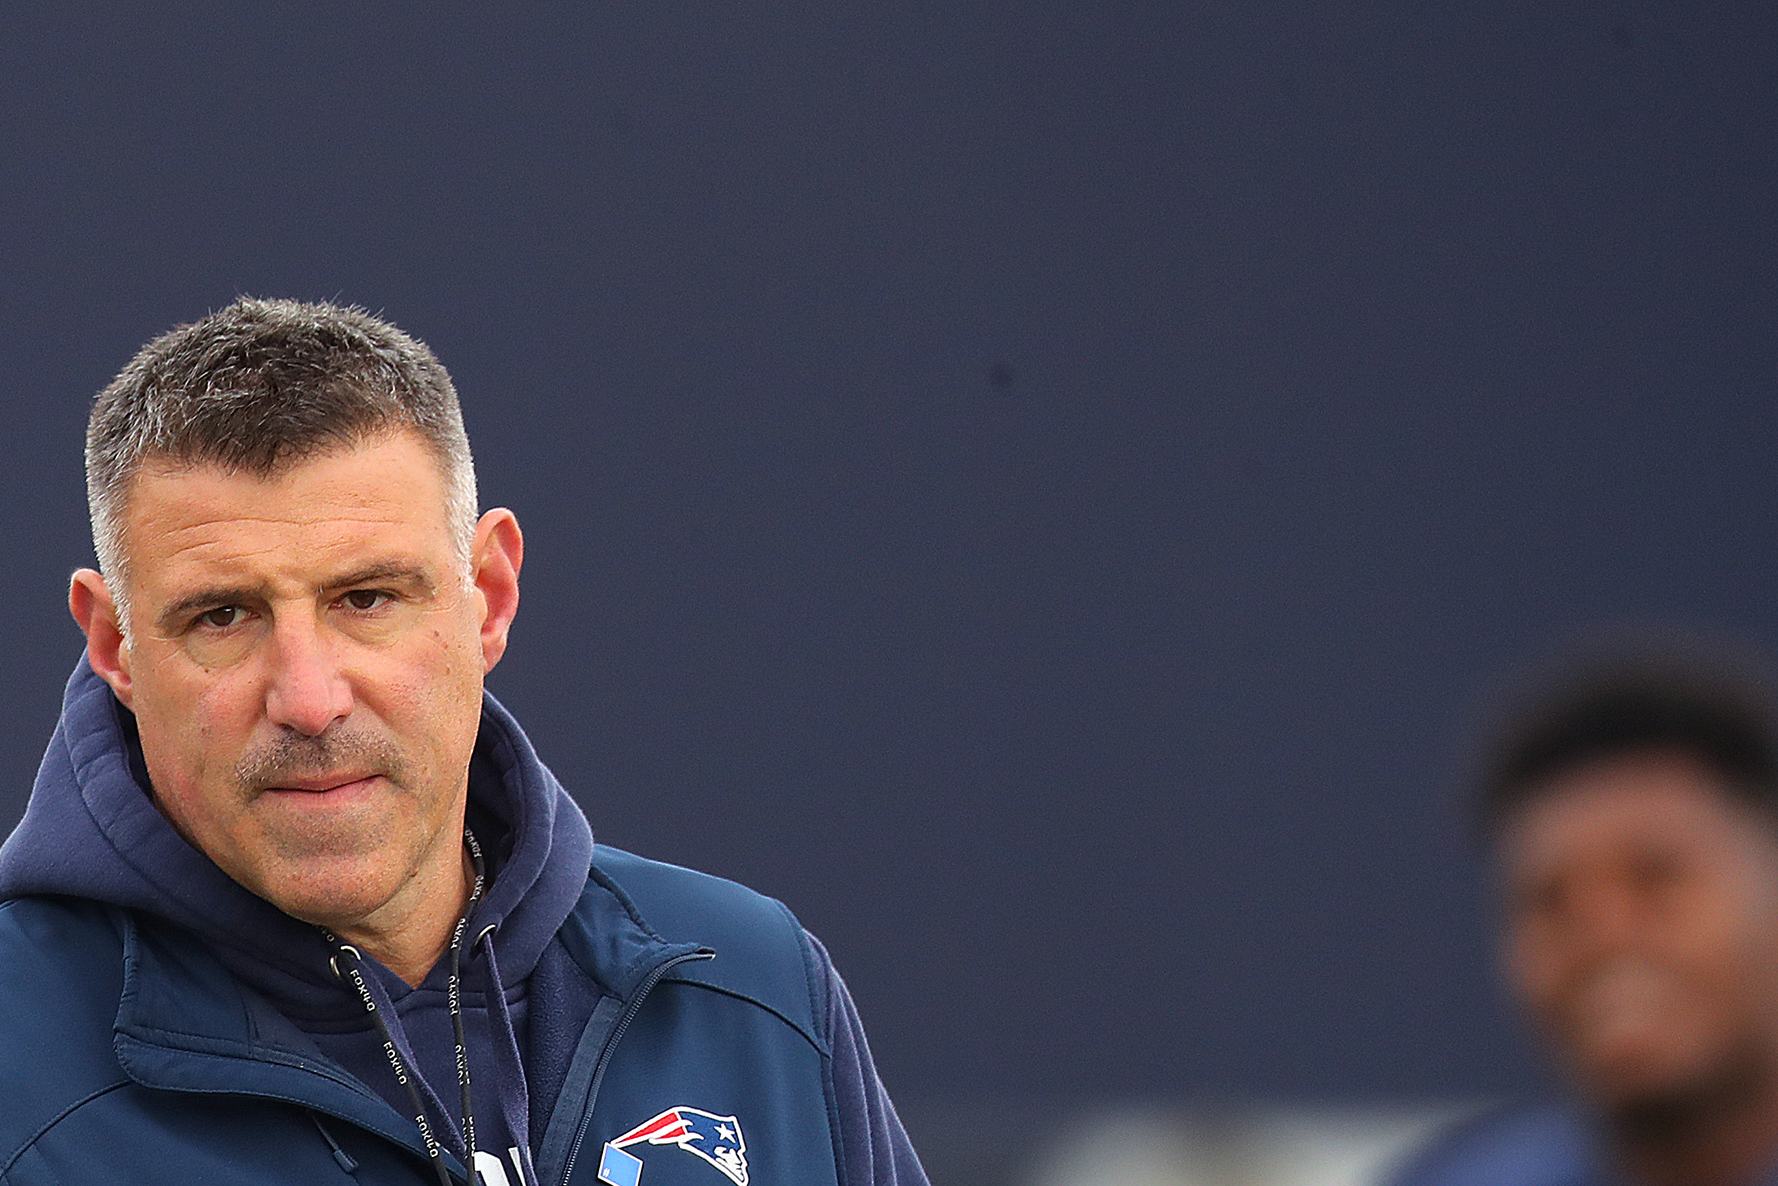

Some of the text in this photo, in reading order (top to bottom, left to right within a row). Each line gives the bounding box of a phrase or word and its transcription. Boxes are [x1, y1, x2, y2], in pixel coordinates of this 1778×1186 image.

[349, 968, 376, 1012] FOX40
[383, 1041, 408, 1085] FOX40
[415, 1114, 439, 1158] FOX40
